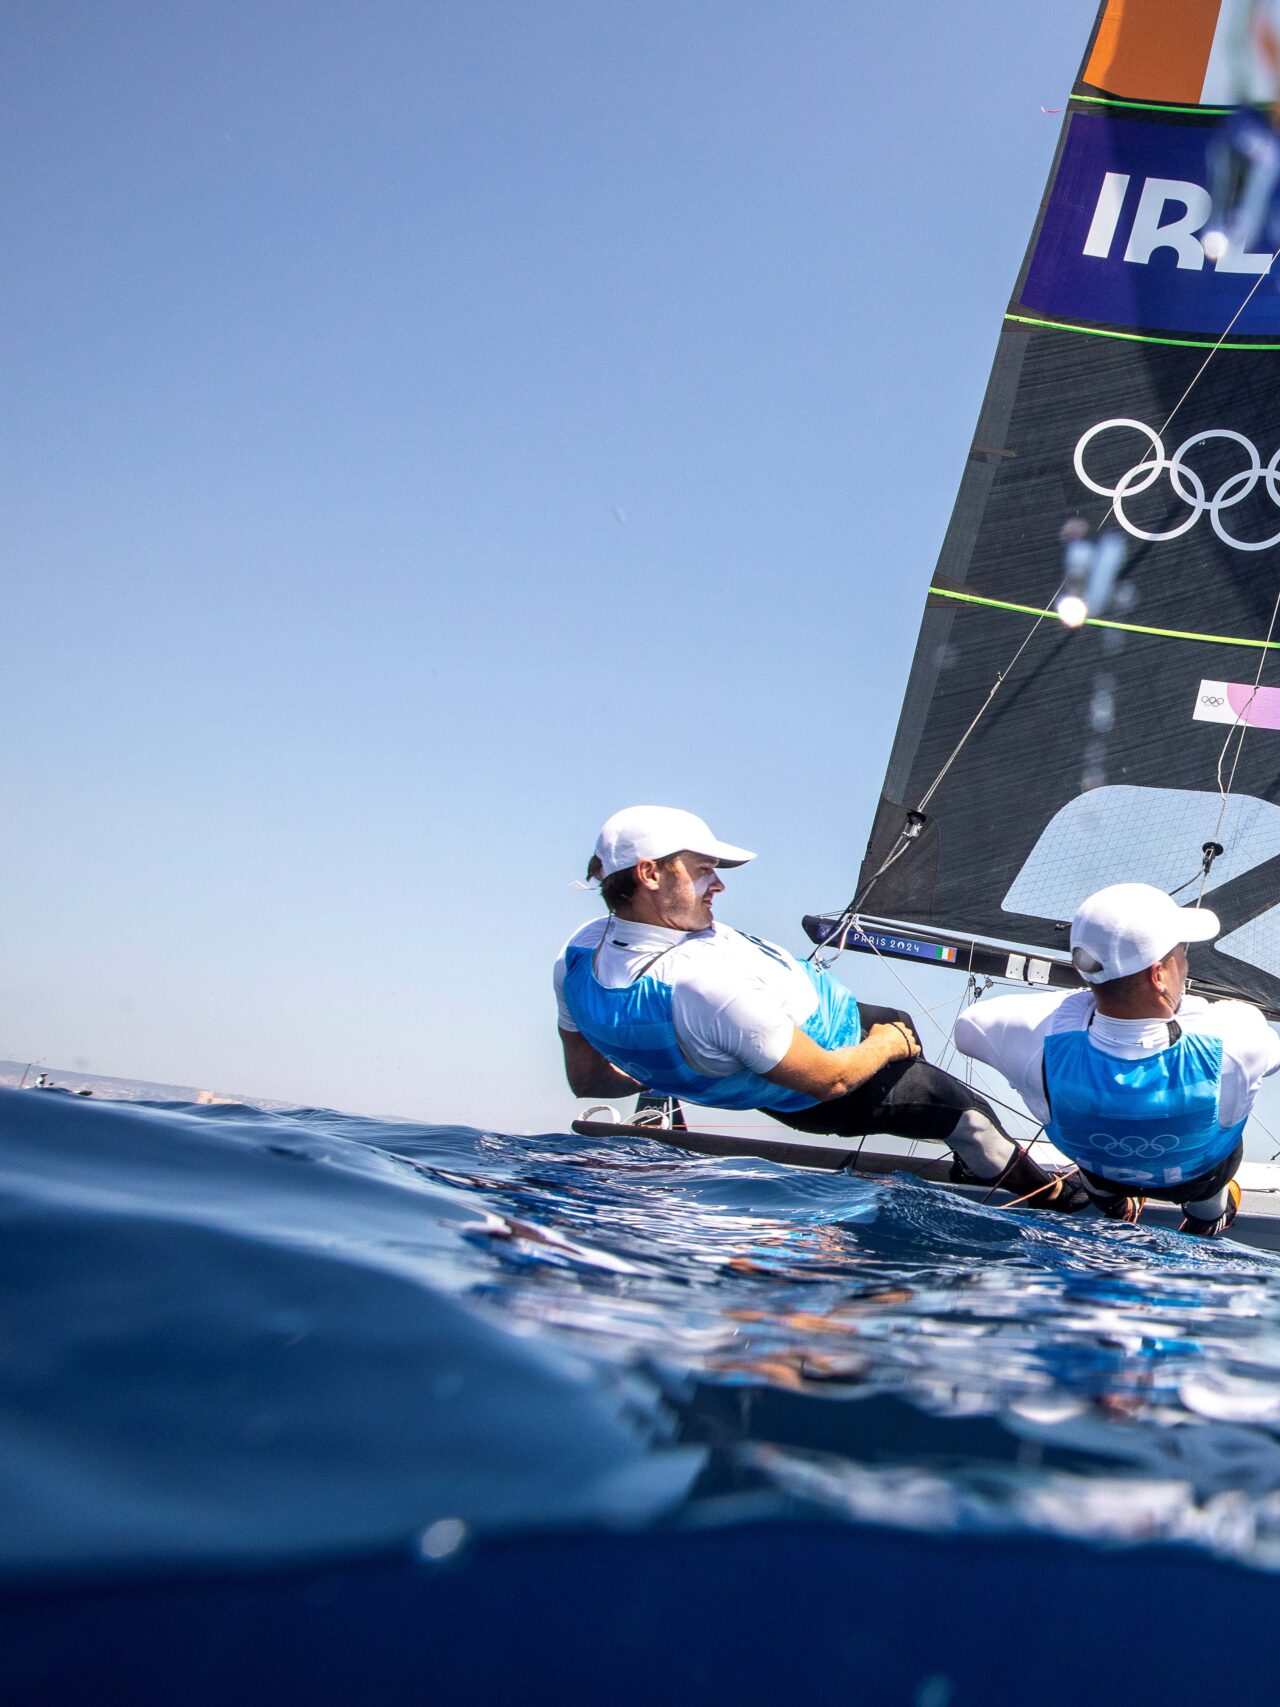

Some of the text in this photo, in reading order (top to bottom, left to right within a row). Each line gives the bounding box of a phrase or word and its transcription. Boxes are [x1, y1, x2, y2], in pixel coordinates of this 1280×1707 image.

[1083, 171, 1273, 275] IRL
[853, 932, 920, 952] PARIS 2024
